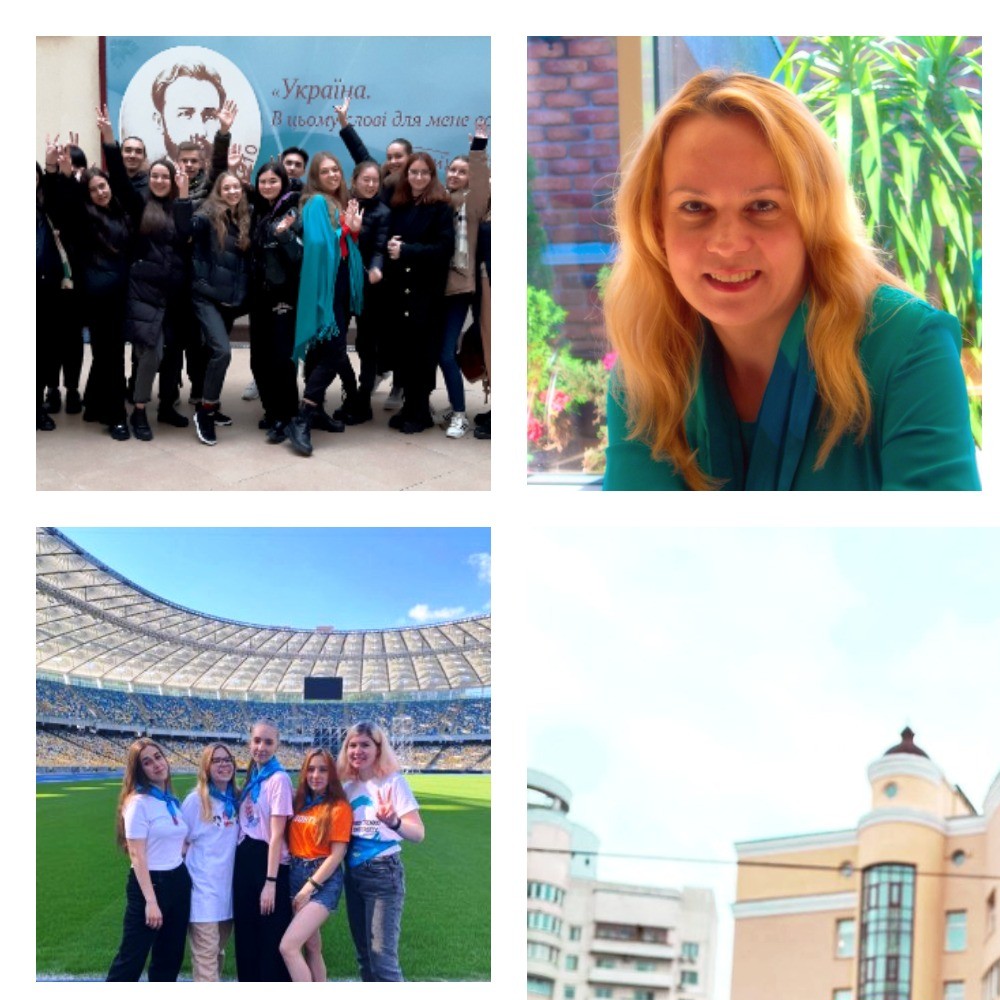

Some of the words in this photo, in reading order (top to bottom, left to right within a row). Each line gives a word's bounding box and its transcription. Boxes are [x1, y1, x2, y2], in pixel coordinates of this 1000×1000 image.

[272, 111, 283, 126] В
[392, 111, 421, 127] для
[425, 115, 469, 127] мене
